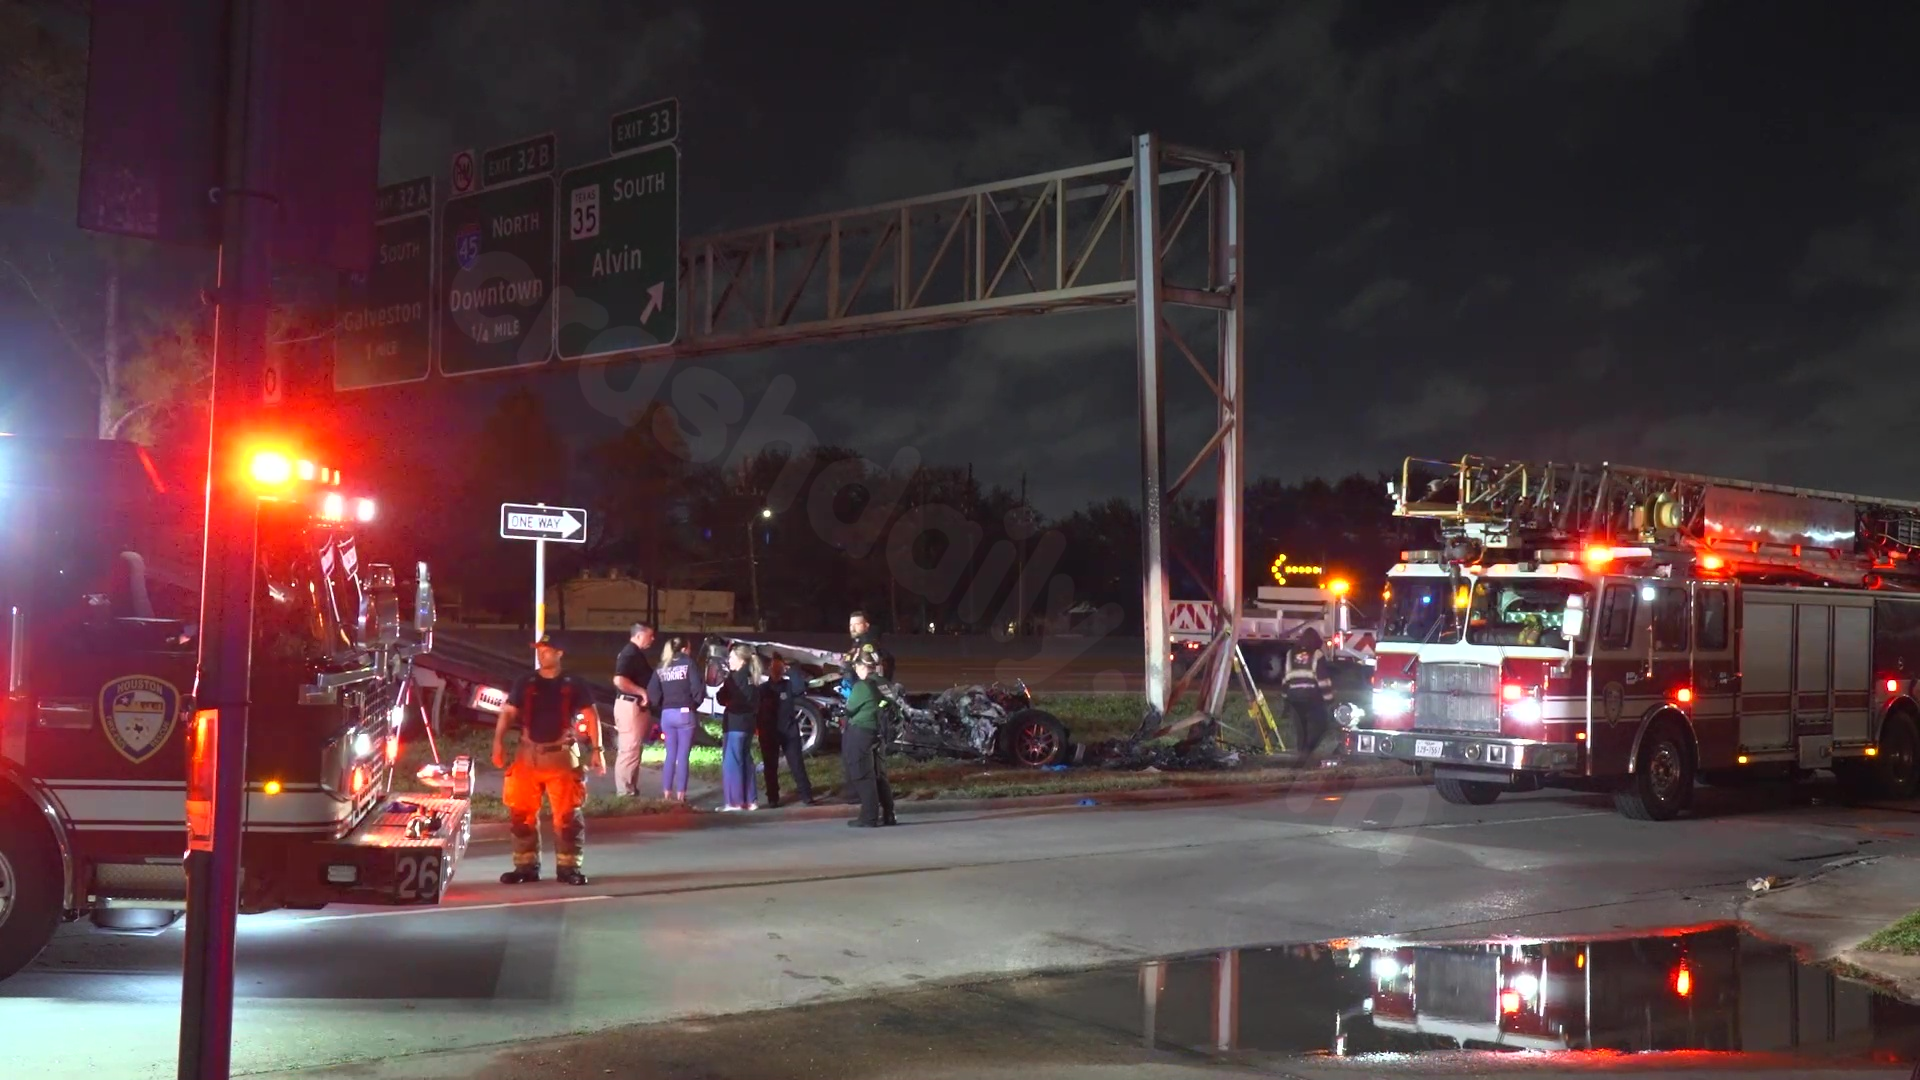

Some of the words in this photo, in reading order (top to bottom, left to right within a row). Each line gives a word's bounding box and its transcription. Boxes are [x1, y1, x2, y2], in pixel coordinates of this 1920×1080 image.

[617, 120, 643, 141] EXIT
[650, 110, 670, 136] 33
[488, 157, 511, 176] EXIT
[575, 189, 597, 203] TEXAS
[613, 172, 665, 201] SOUTH
[492, 212, 540, 238] NORTH
[573, 205, 597, 235] 35
[381, 242, 420, 264] SOUTH
[459, 236, 478, 259] 45
[592, 244, 642, 277] Alvin
[451, 279, 543, 312] Downtown
[344, 302, 421, 332] Galveston
[494, 320, 519, 338] MILE
[511, 515, 533, 528] ONE
[539, 518, 561, 529] WAY
[117, 679, 163, 695] HOUSTON
[397, 855, 439, 898] 26
